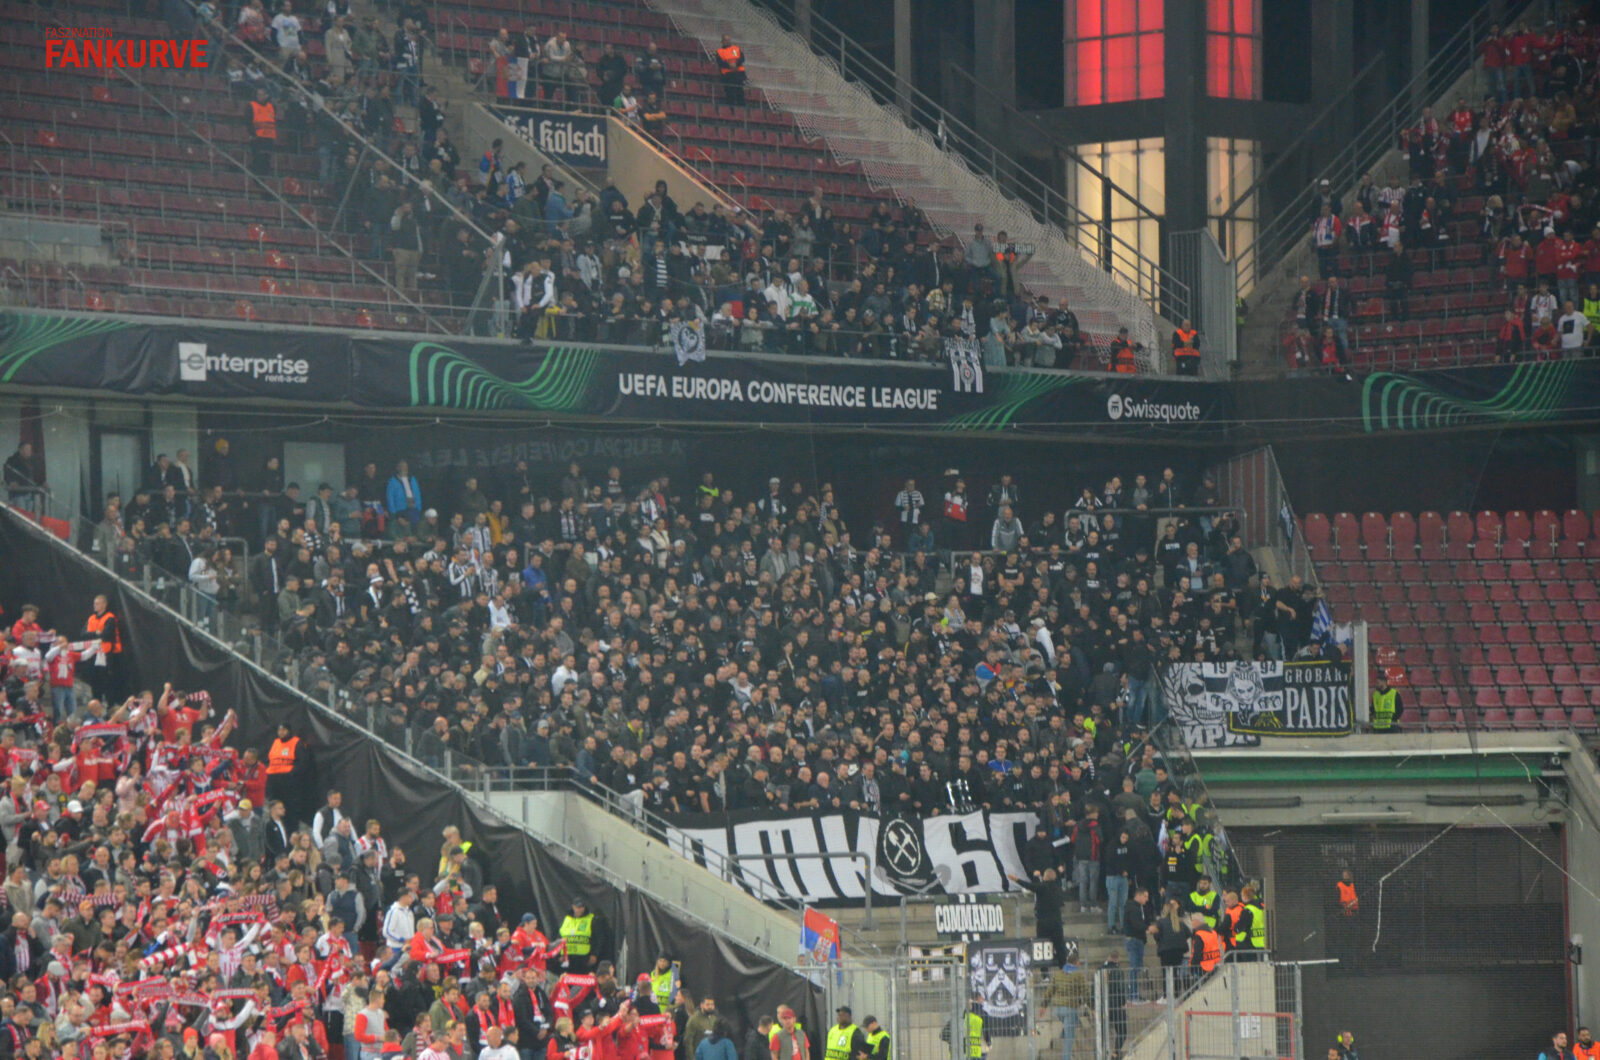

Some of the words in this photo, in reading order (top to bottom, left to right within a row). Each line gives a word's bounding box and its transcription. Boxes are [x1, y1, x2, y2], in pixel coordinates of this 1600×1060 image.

[539, 119, 606, 162] Kölsch
[186, 352, 309, 379] enterprise
[264, 374, 309, 384] rent-a-car
[618, 372, 668, 396] UEFA
[672, 375, 744, 402] EUROPA
[747, 380, 866, 408] CONFERENCE
[871, 386, 938, 410] LEAGUE
[1124, 396, 1201, 424] Swissquote
[1284, 685, 1349, 729] PARIS
[935, 904, 1004, 933] COMMANDO
